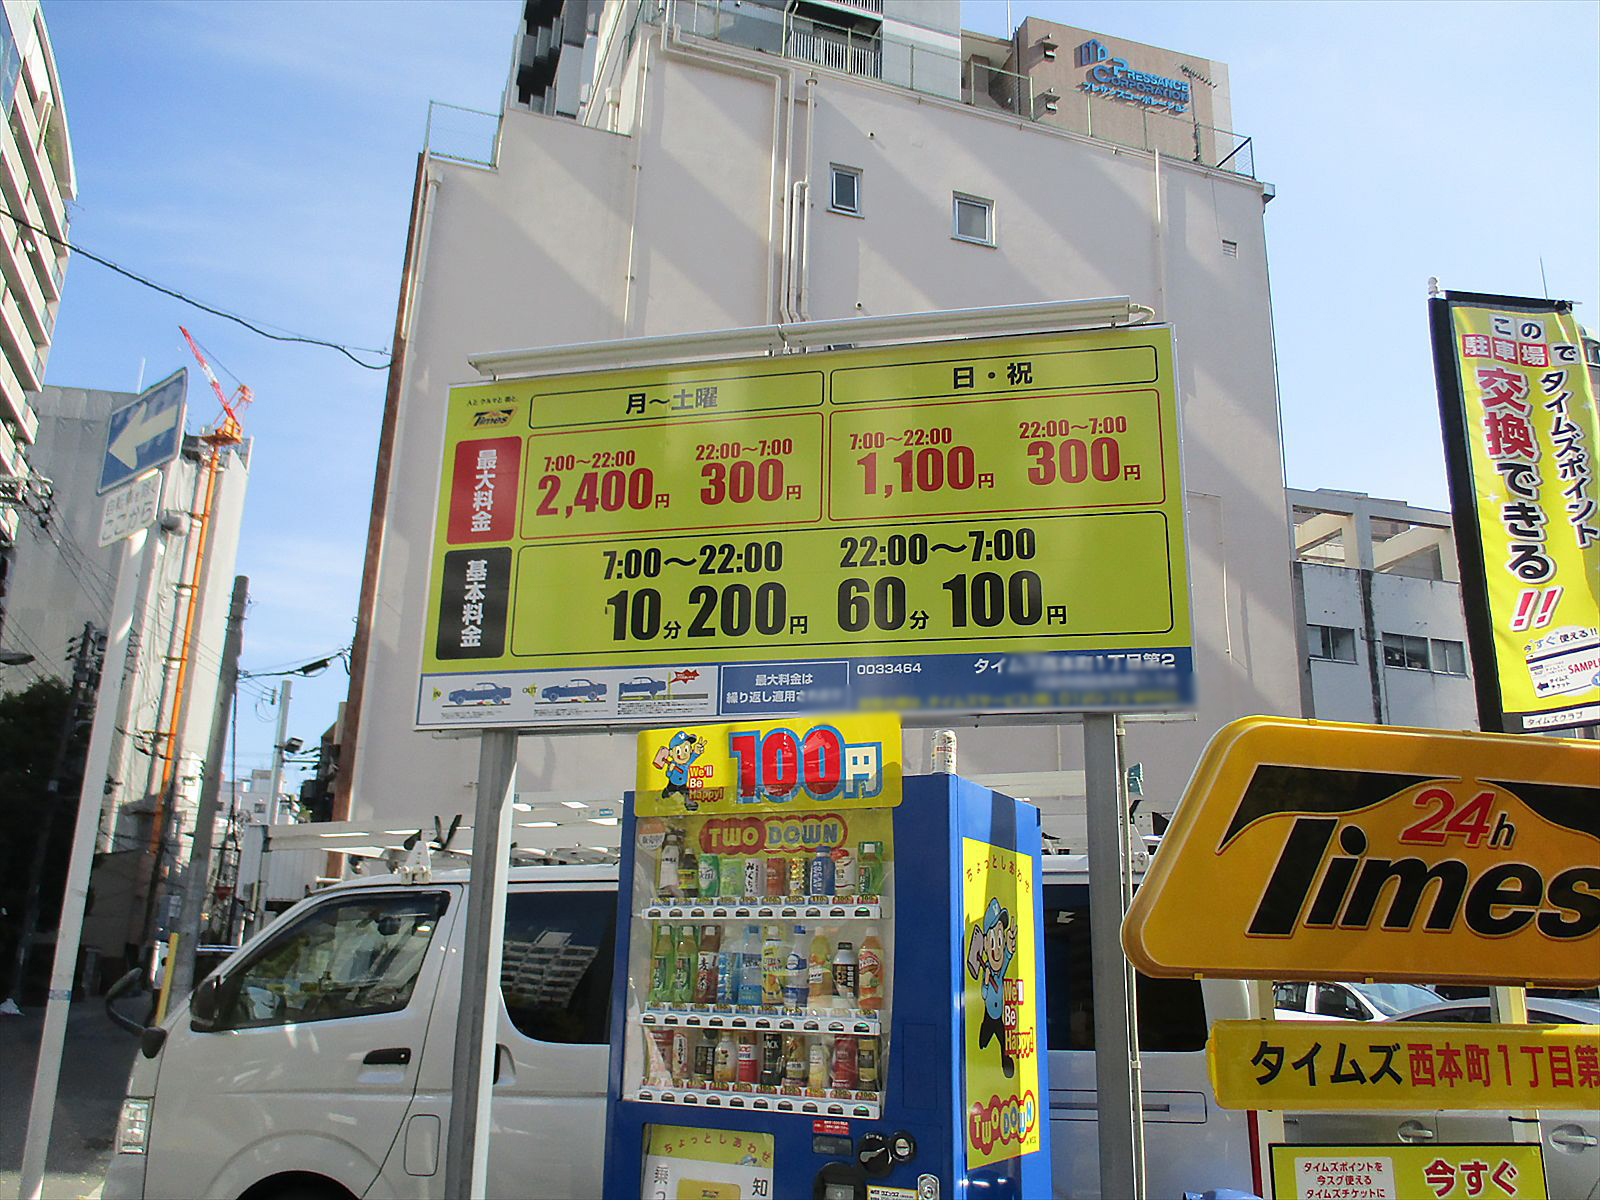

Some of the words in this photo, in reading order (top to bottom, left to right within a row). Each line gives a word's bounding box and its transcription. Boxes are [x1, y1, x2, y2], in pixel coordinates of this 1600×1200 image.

[1110, 57, 1190, 91] PRESSANCE
[1493, 317, 1542, 340] この
[953, 362, 1033, 390] 日・祝
[1540, 371, 1599, 546] タイムズポイント
[470, 448, 498, 533] 最大料金
[460, 558, 489, 649] 基本料金
[755, 673, 813, 686] 最大料金は
[856, 662, 923, 675] 0033464
[689, 766, 713, 777] We'll
[729, 725, 882, 804] 100円
[689, 779, 703, 788] Be
[1401, 788, 1515, 849] 24h
[708, 826, 762, 848] TWO
[768, 823, 839, 846] DOWN
[1245, 812, 1600, 940] Times
[1005, 1005, 1016, 1025] Be
[974, 1107, 999, 1146] TWO
[1003, 1101, 1032, 1134] DOWN
[1304, 1161, 1384, 1174] タイムズポイントを
[1317, 1174, 1372, 1186] 今スグ使える
[1424, 1159, 1518, 1198] 今すぐ
[1306, 1187, 1386, 1200] タイムズチケットに
